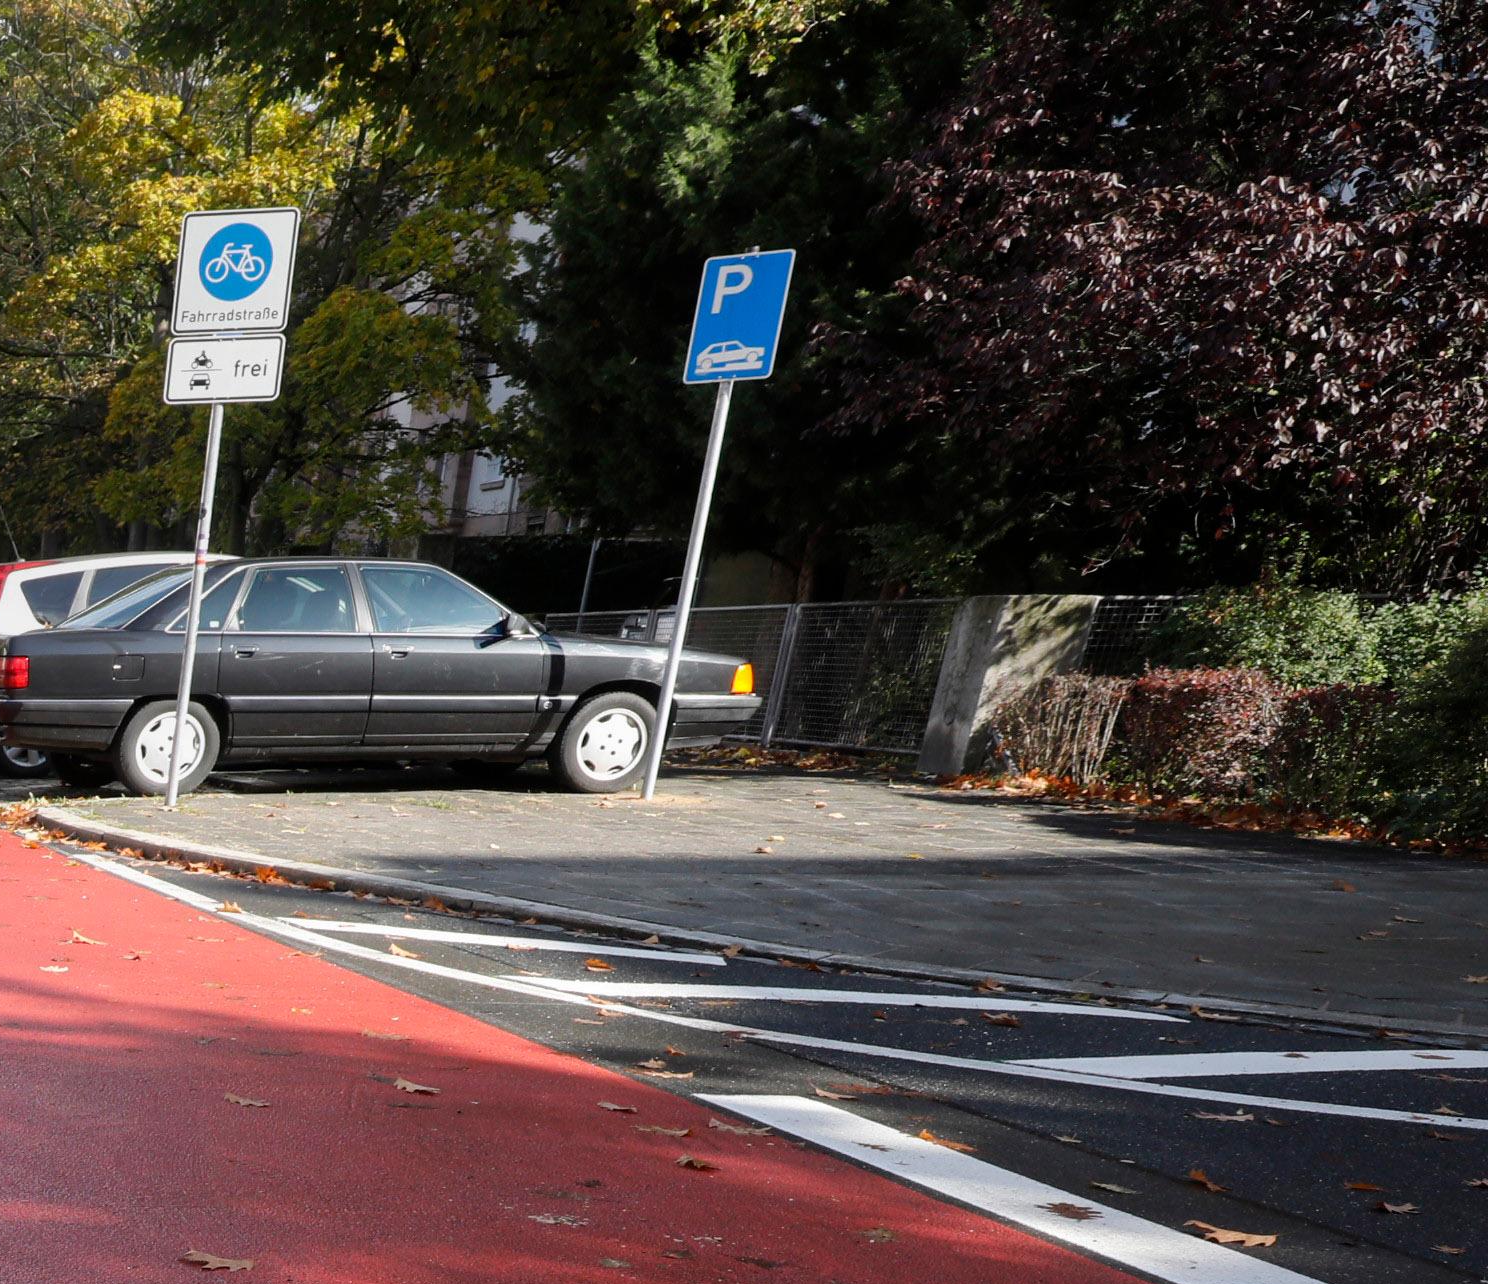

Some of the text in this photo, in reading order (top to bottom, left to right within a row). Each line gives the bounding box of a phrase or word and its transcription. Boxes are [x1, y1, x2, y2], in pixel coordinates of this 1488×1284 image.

[711, 264, 753, 314] P
[181, 307, 278, 323] Fahrradstraße
[234, 359, 268, 378] frei
